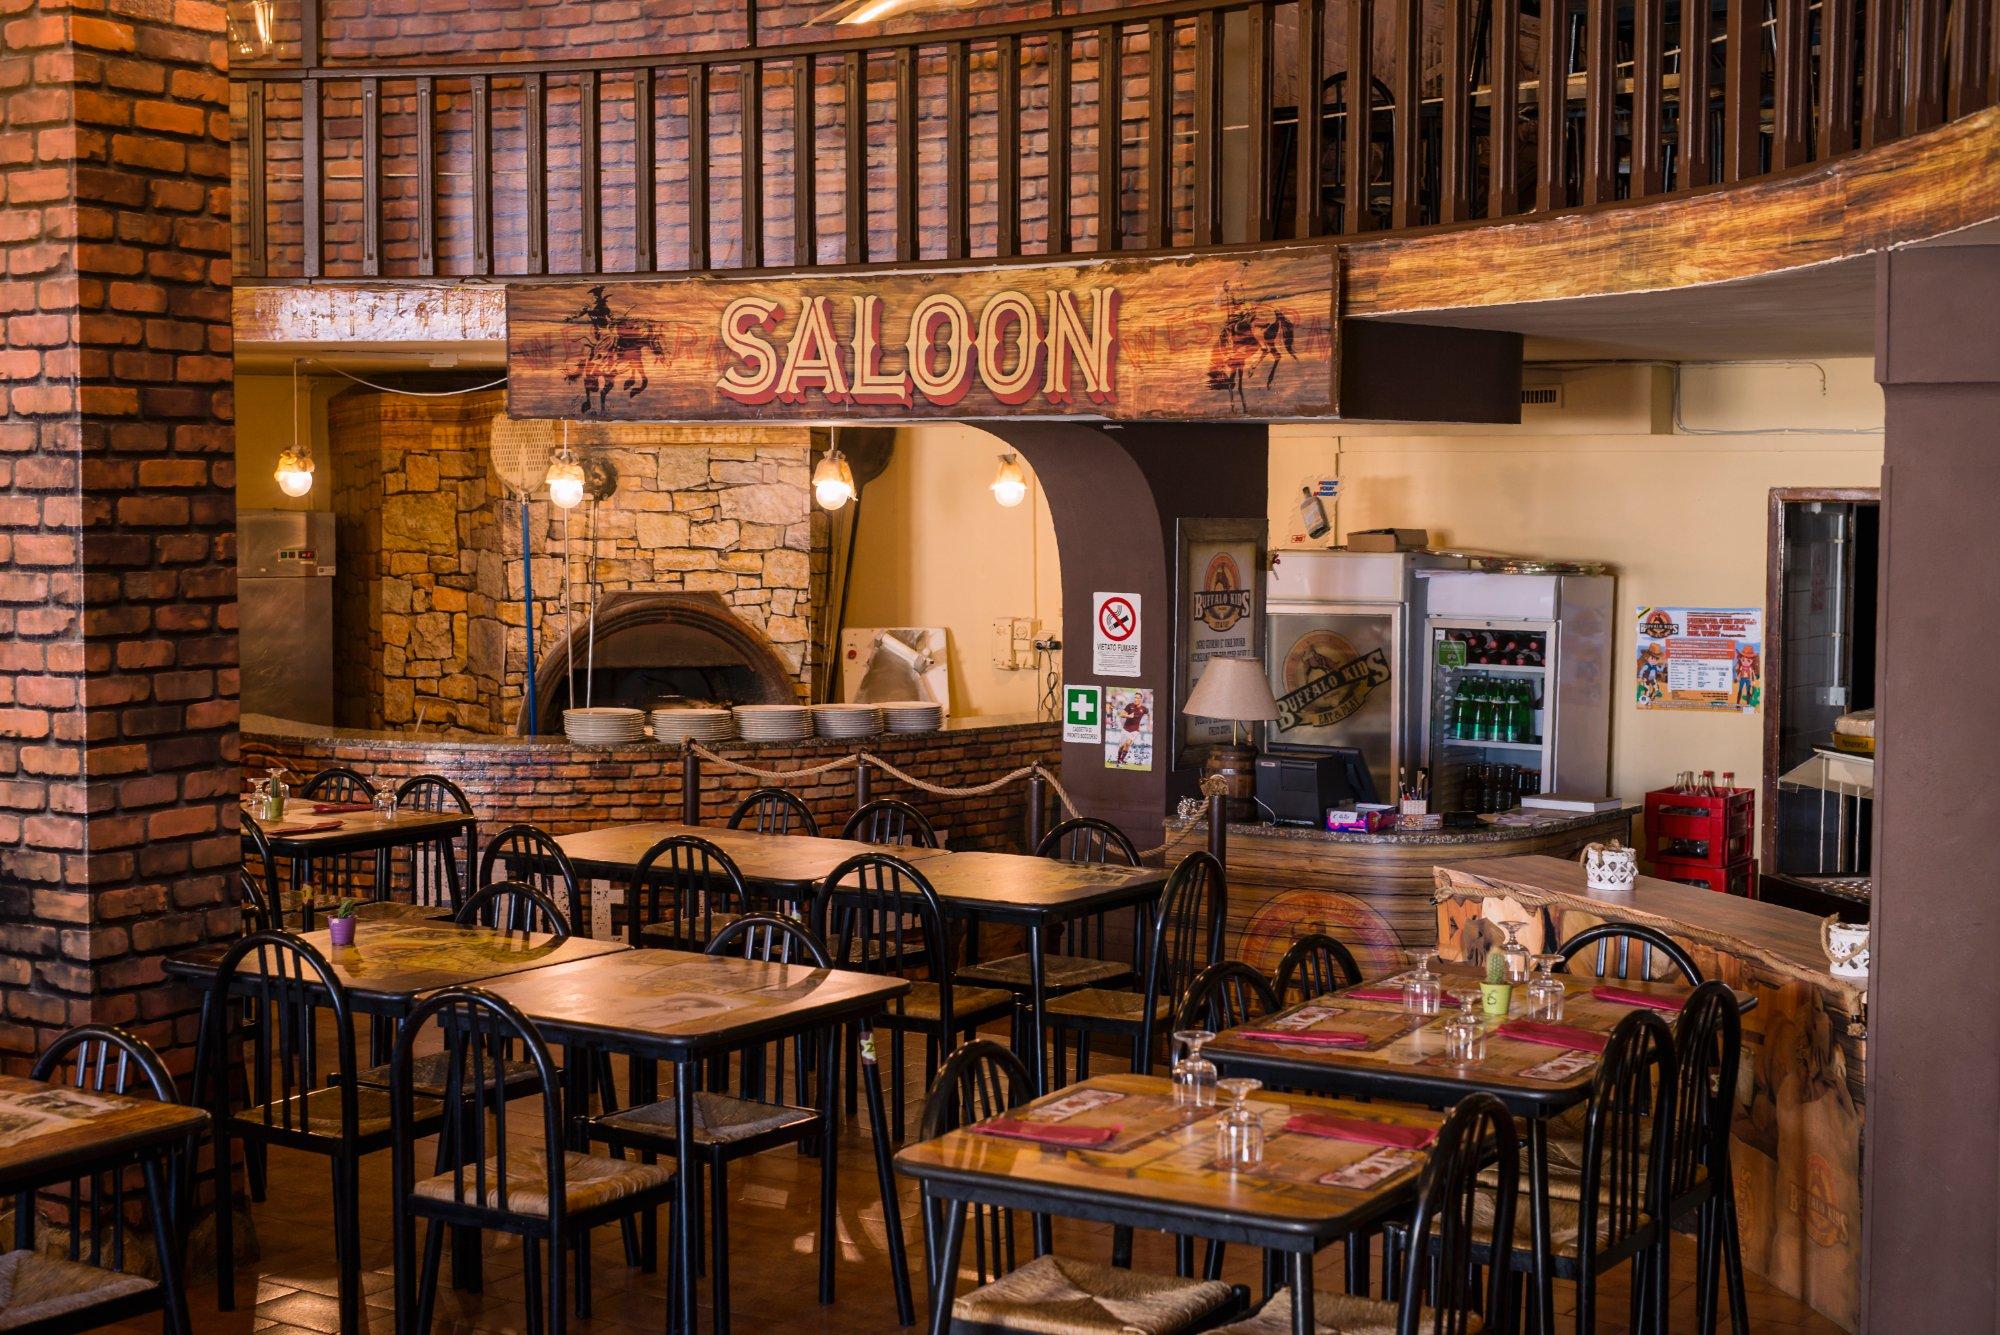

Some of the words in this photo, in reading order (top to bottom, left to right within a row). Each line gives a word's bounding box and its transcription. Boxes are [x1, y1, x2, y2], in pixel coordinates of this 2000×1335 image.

[716, 286, 1122, 412] SALOON
[1195, 593, 1229, 619] BUFFALO
[1230, 591, 1250, 617] KIDS
[1097, 642, 1117, 652] VIETATO
[1117, 643, 1138, 653] FUMARE
[1276, 675, 1338, 731] BUFFALO
[1341, 652, 1390, 684] KIDS
[1319, 713, 1333, 724] EAT
[1487, 989, 1497, 1006] 6
[865, 1041, 875, 1053] 2
